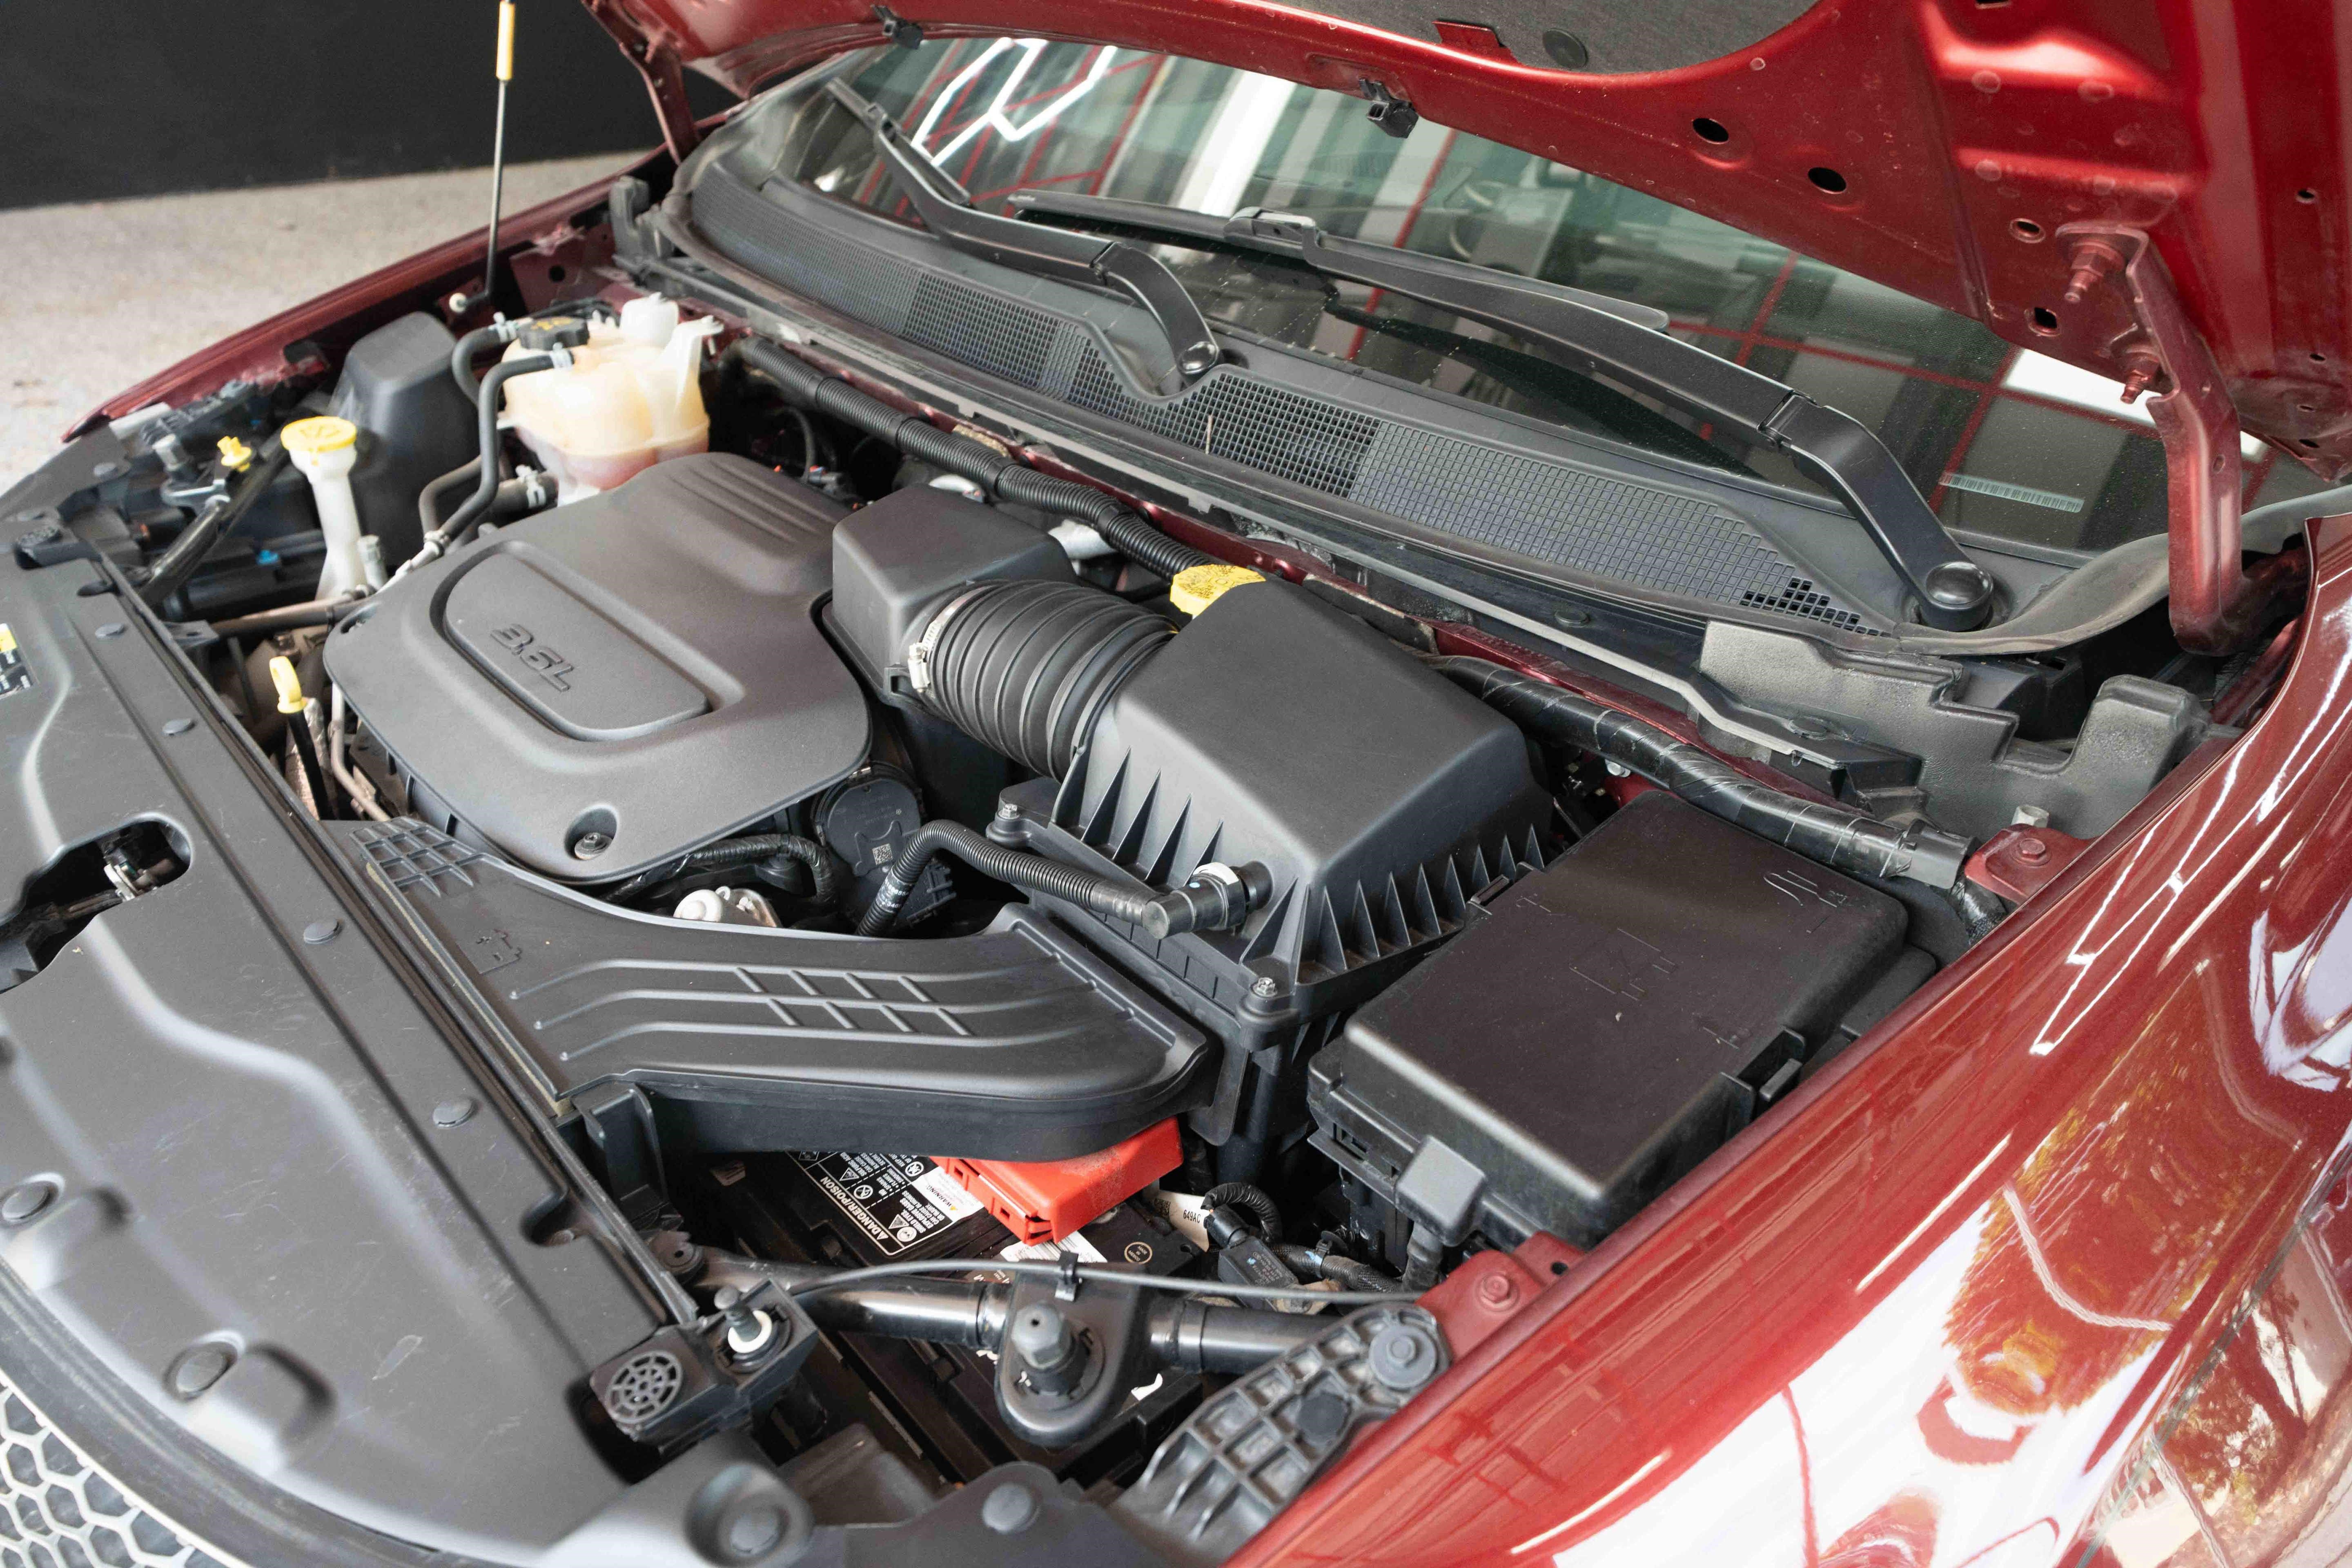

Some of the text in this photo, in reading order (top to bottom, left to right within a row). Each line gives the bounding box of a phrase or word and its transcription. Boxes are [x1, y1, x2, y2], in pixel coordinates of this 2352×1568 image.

[490, 623, 574, 693] 3.6L
[821, 1177, 882, 1235] DANGER/POISON
[1183, 1209, 1201, 1223] 649AC
